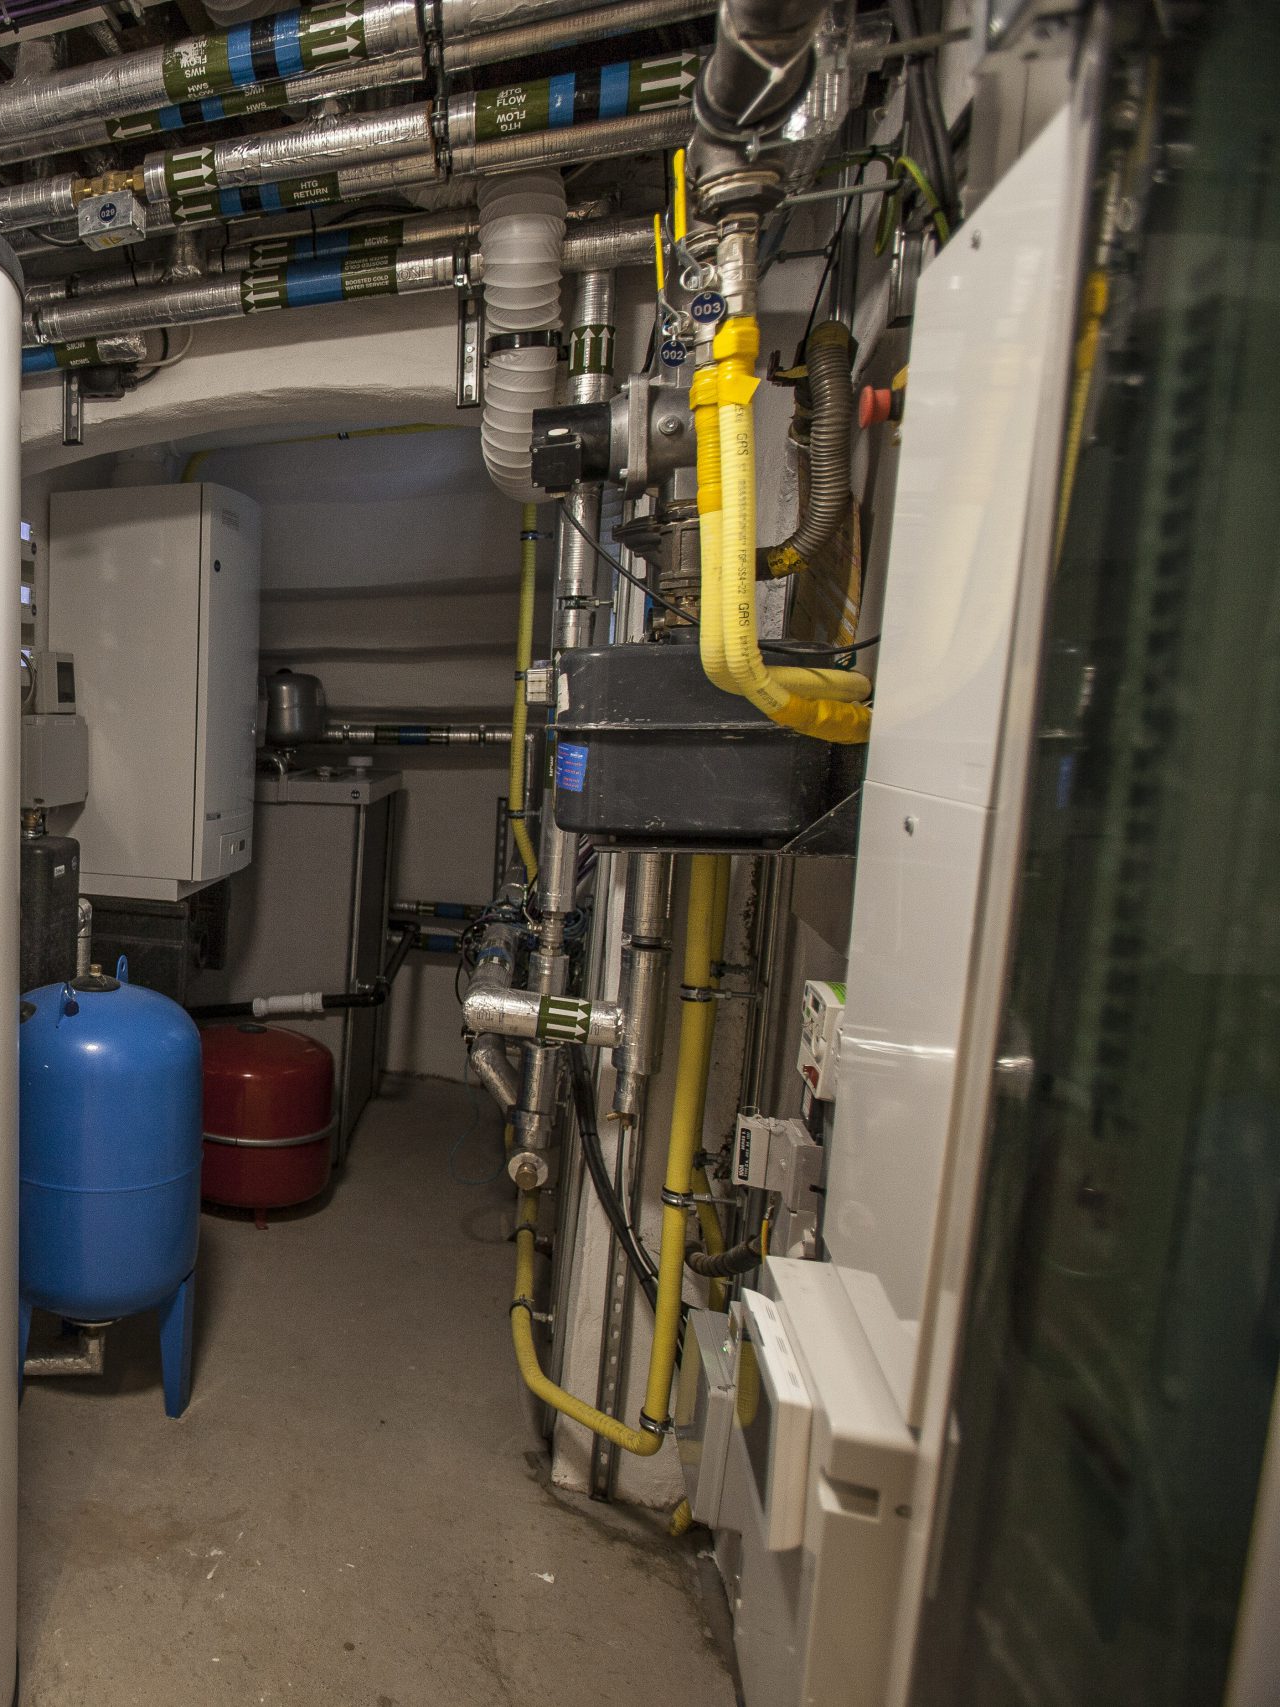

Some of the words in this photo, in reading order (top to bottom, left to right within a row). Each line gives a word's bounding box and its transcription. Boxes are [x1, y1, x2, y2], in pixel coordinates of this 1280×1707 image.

[184, 66, 206, 79] HWS
[187, 82, 209, 93] HWS
[496, 94, 527, 107] FLOW
[246, 101, 267, 113] HWS
[496, 110, 526, 124] FLOW
[500, 121, 521, 132] HTG
[300, 181, 318, 190] HTG
[293, 187, 329, 200] RETURN
[345, 277, 372, 286] BOOSTED
[365, 280, 389, 288] SERVICE
[694, 302, 721, 316] 003
[663, 350, 683, 360] 002
[736, 432, 749, 456] GAS
[738, 602, 749, 627] GAS
